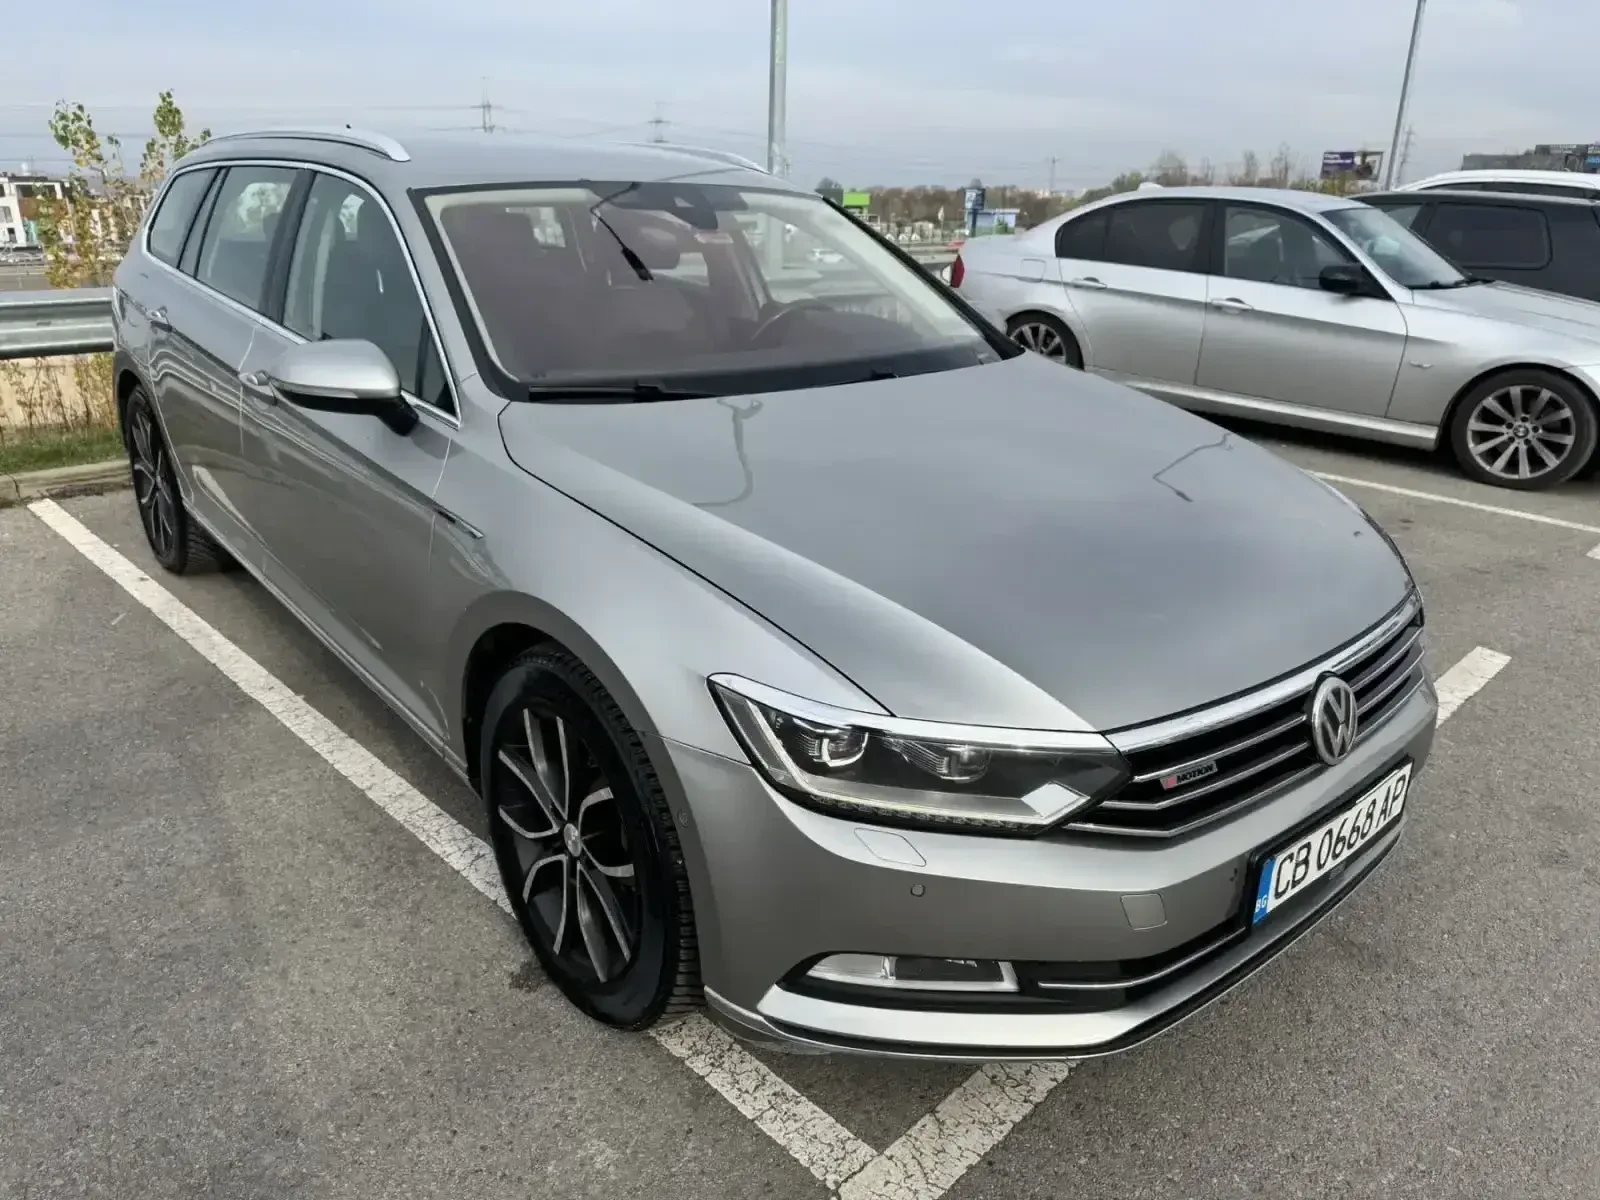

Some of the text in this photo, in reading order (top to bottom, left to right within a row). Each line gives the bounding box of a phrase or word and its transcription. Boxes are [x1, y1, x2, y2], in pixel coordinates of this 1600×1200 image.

[1316, 681, 1354, 762] VW
[1274, 774, 1406, 900] CB 0668 AP
[1255, 894, 1268, 913] BG
